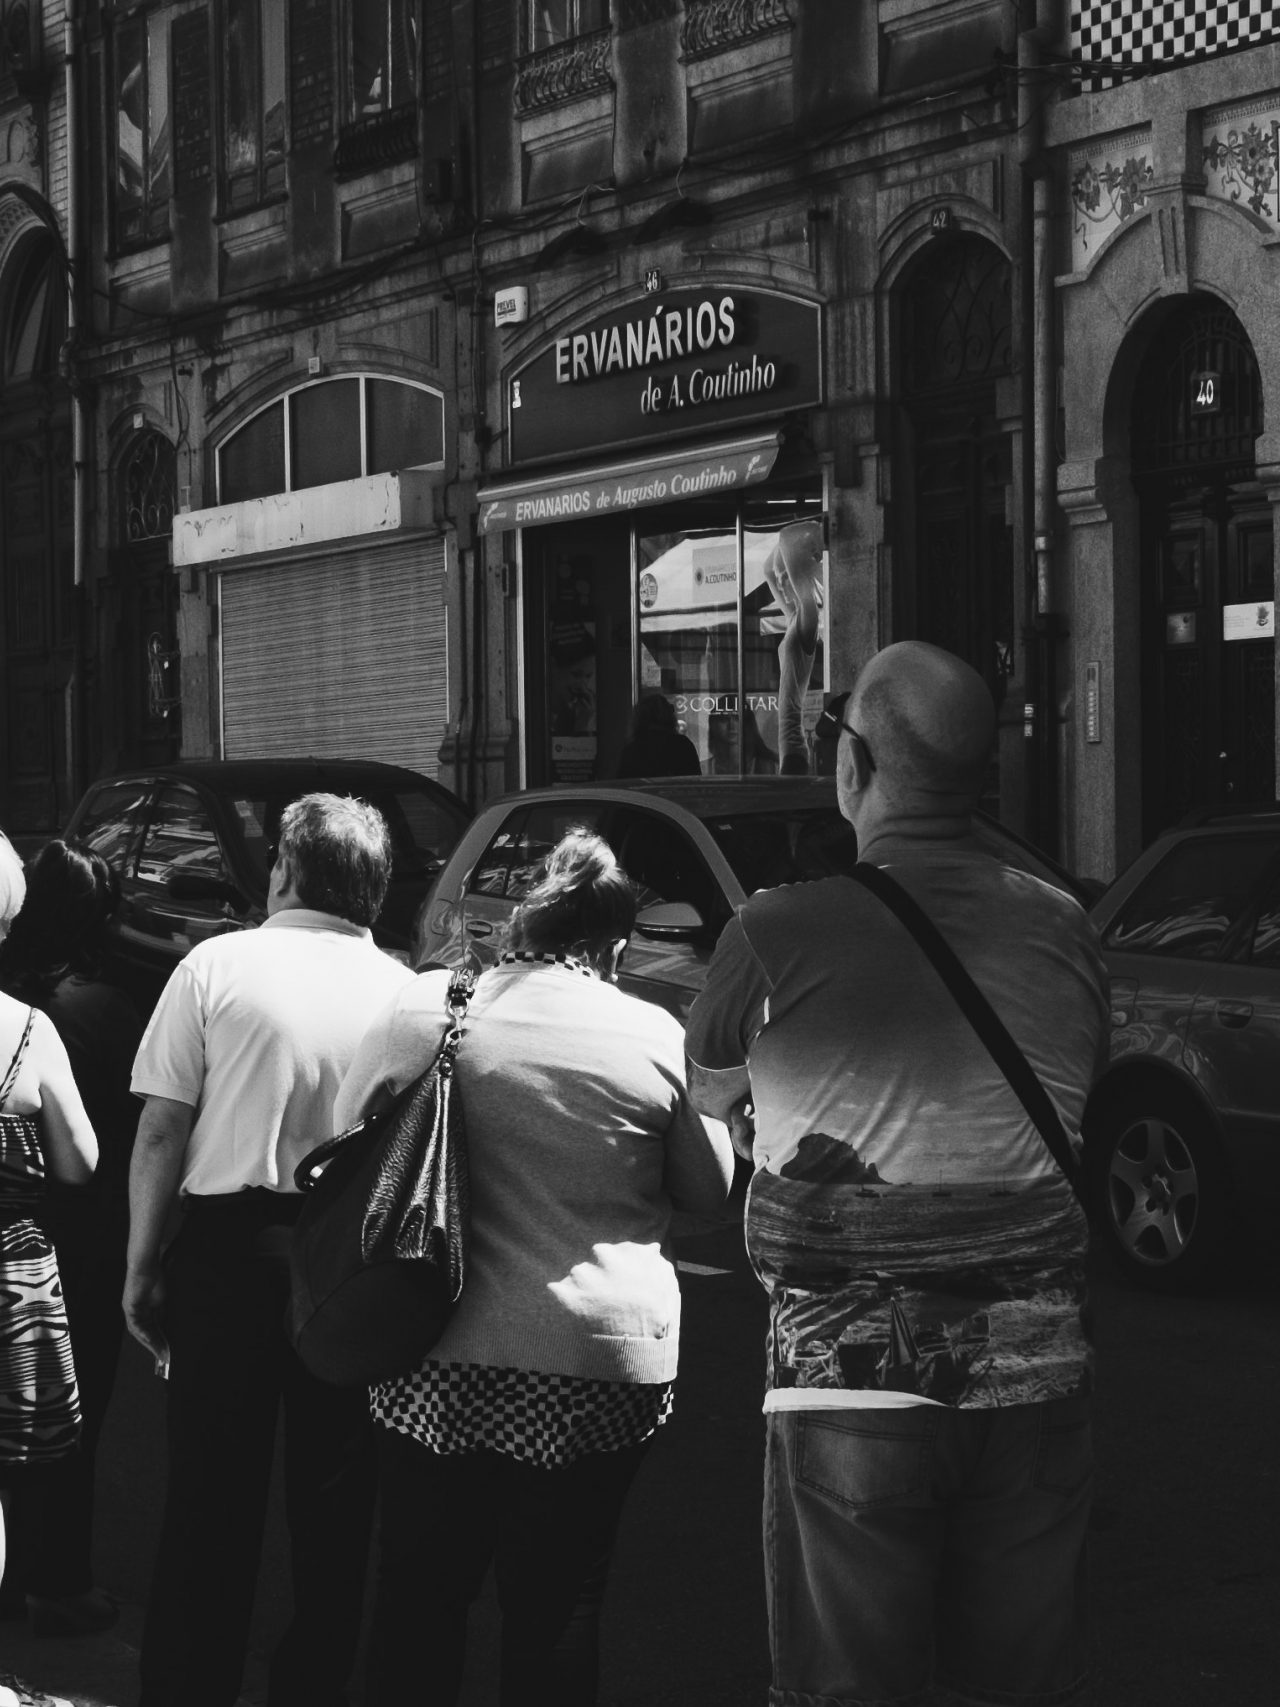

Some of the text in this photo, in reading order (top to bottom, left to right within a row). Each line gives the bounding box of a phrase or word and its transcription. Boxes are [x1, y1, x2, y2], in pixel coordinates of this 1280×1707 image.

[933, 211, 947, 229] 42
[646, 271, 658, 291] 46
[555, 296, 736, 384] ERVANÁRIOS
[641, 354, 776, 415] de A. Coutinho
[1196, 379, 1214, 406] 40
[514, 464, 737, 522] ERVANARIOS de Augusto Coutinho
[689, 695, 780, 713] COLLITAR
